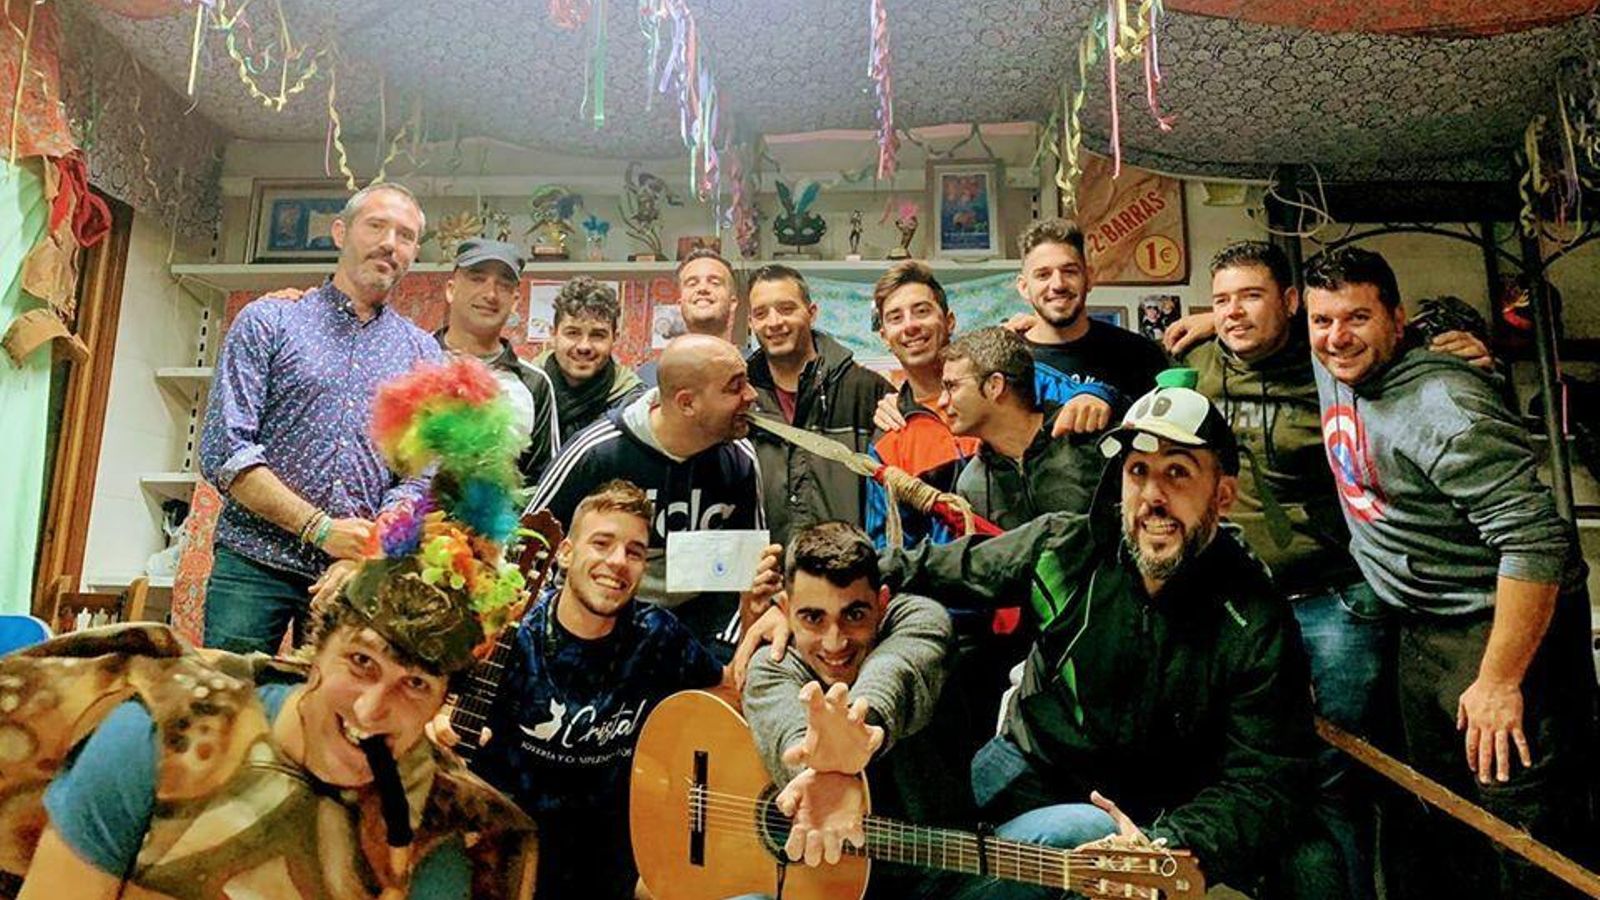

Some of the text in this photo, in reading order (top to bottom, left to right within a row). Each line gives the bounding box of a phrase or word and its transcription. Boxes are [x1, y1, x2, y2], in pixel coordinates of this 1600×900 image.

[1088, 191, 1165, 253] 2 BARRAS
[561, 699, 647, 748] Cristal
